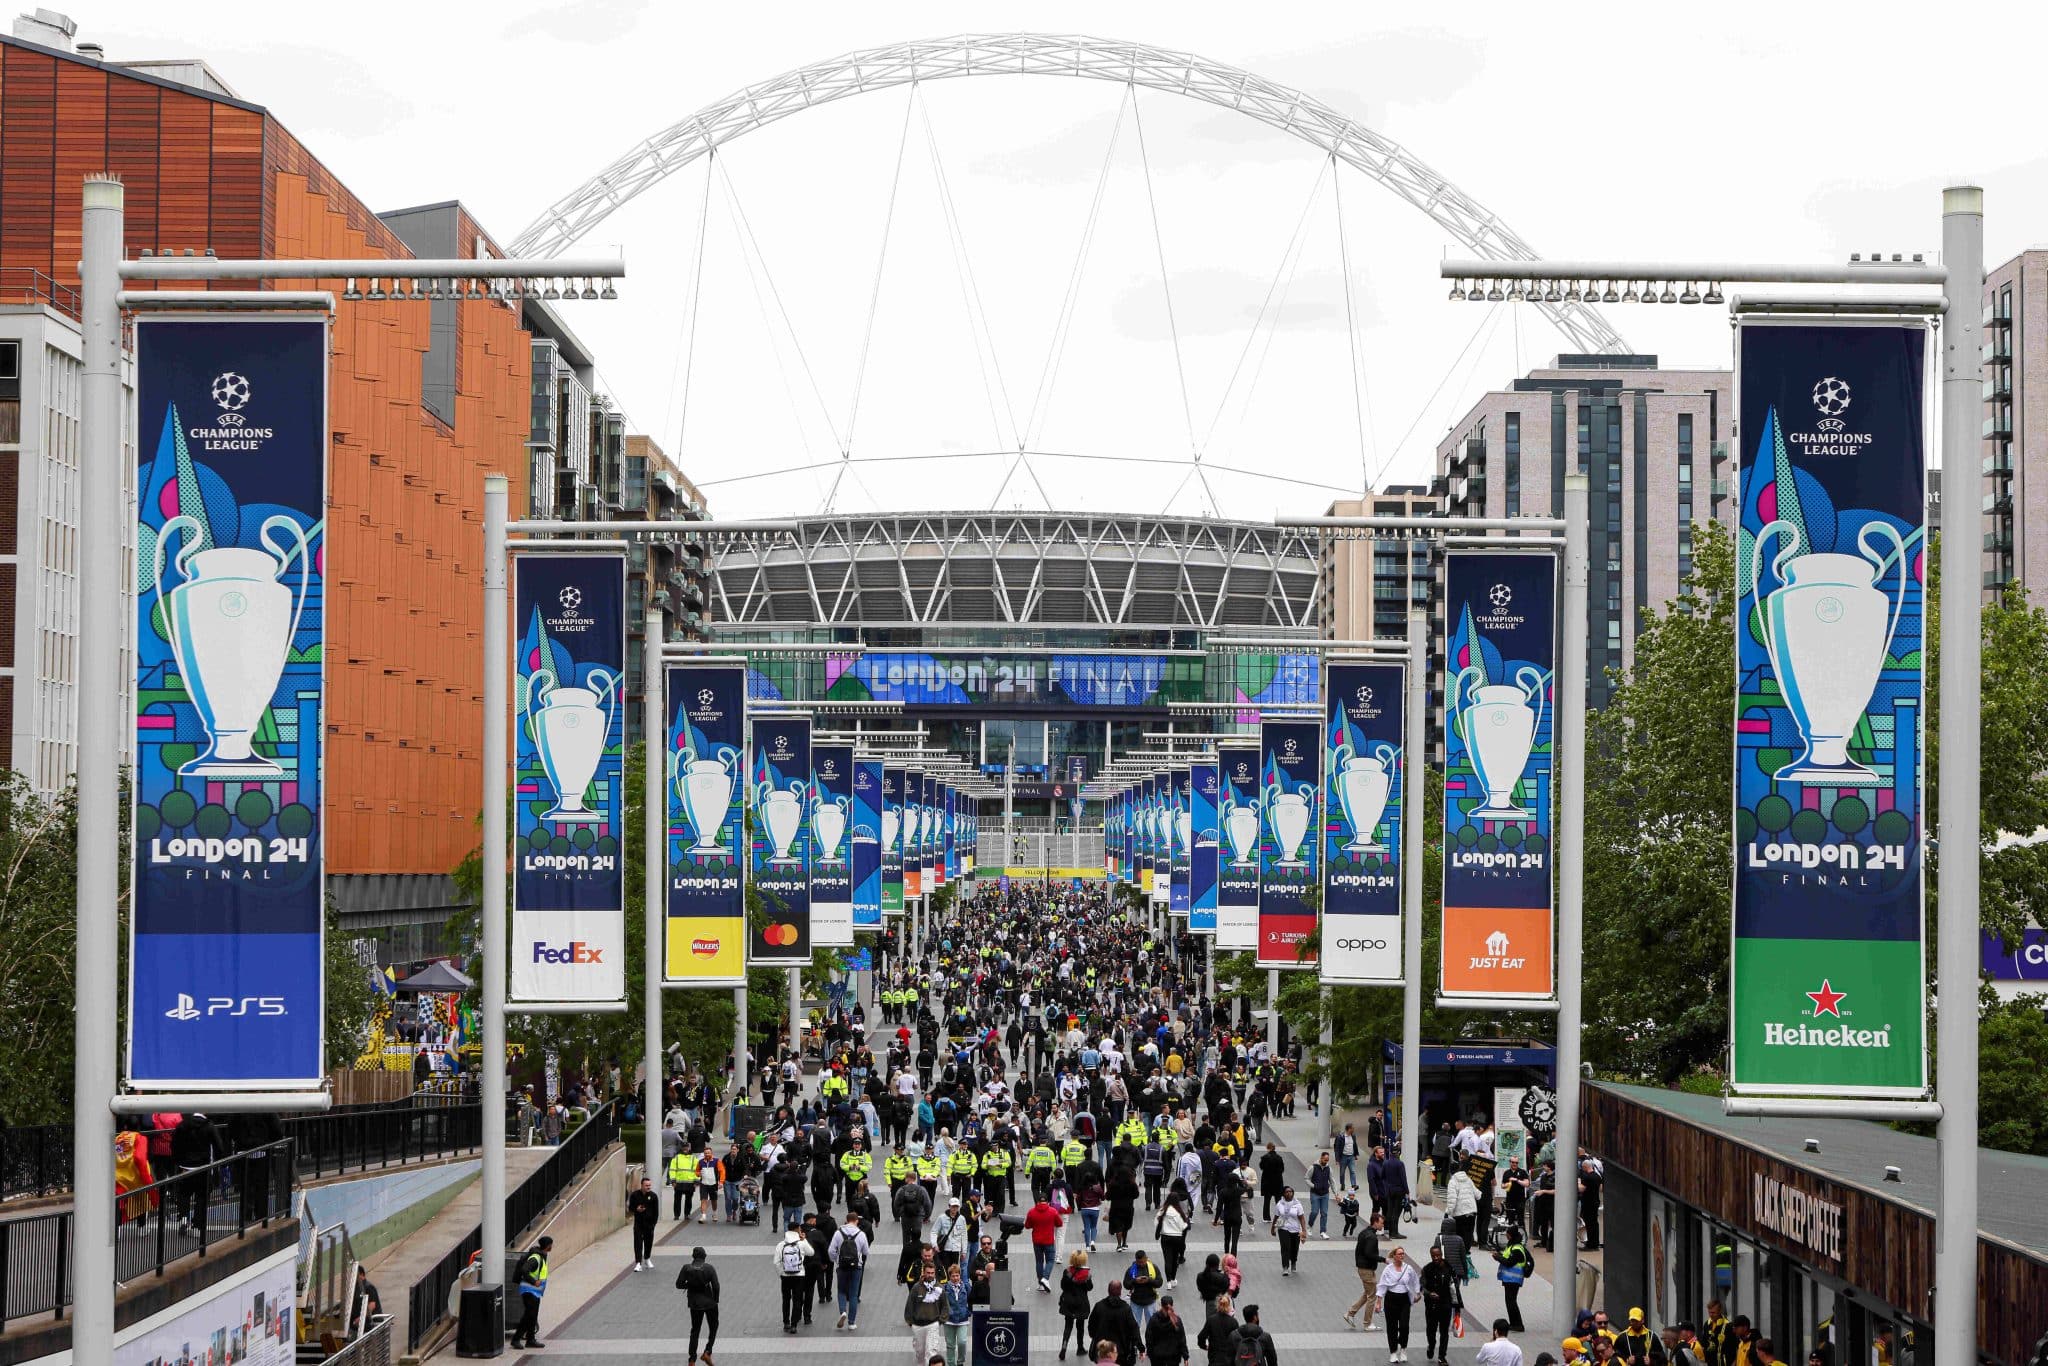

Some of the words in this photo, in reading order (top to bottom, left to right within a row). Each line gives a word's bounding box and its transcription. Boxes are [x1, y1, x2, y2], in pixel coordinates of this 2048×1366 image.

[190, 428, 273, 438] CHAMPIONS
[1790, 433, 1873, 443] CHAMPIONS
[205, 440, 259, 450] LEAGUE
[1804, 445, 1858, 455] LEAGUE
[994, 666, 1035, 692] 24
[1048, 667, 1160, 693] FINAL
[269, 838, 307, 862] 24
[1520, 854, 1543, 868] 24
[1866, 845, 1904, 869] 24
[592, 856, 614, 870] 24
[186, 870, 271, 879] FINAL
[722, 878, 738, 889] 24
[793, 881, 805, 890] 24
[1378, 876, 1394, 887] 24
[1783, 875, 1868, 886] FINAL
[533, 941, 603, 964] FedEx
[1469, 958, 1499, 969] JUST
[1502, 958, 1526, 969] EAT
[208, 997, 285, 1016] PS5
[1754, 1172, 1780, 1233] BLACK
[1780, 1183, 1807, 1245] SHEEP
[1806, 1195, 1841, 1262] COFFEE
